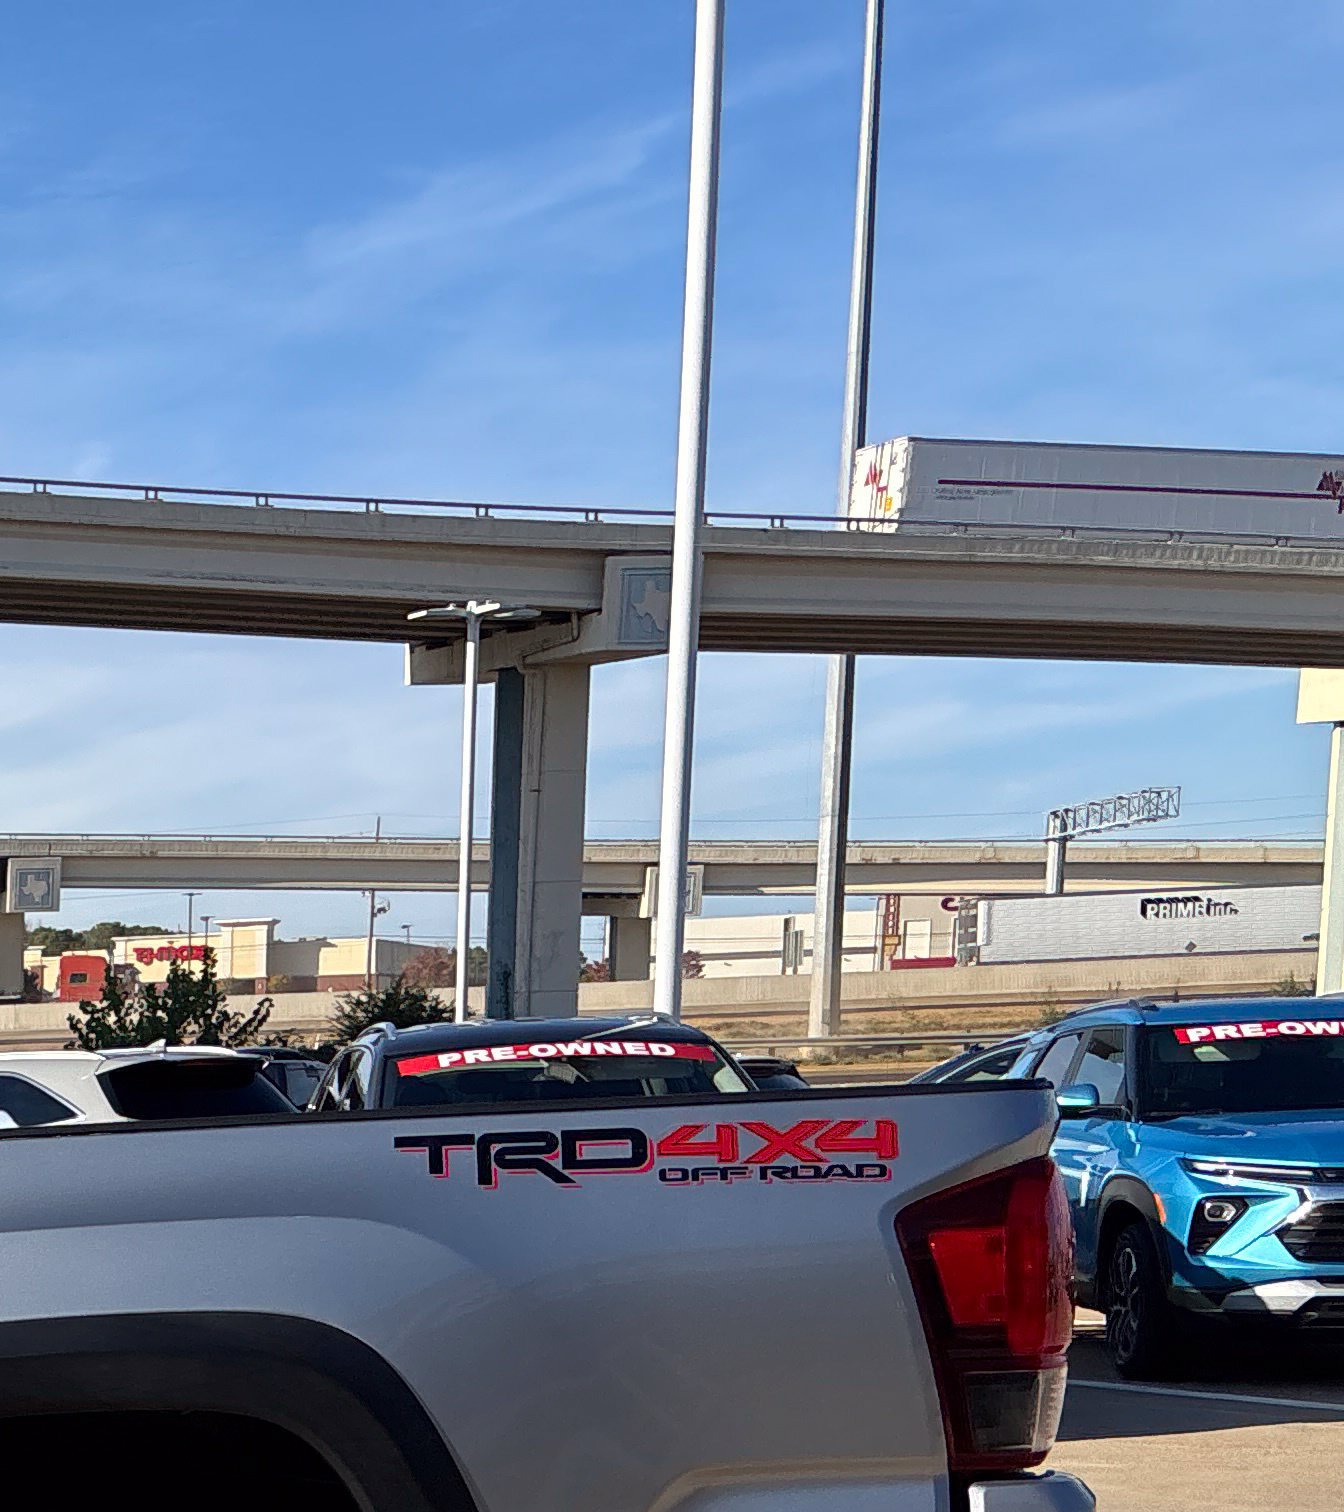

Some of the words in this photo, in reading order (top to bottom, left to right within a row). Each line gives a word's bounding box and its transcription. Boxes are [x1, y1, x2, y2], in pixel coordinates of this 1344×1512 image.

[1186, 1021, 1344, 1043] PRE-OW
[437, 1042, 676, 1067] PRE-OWNED
[394, 1127, 655, 1189] TRD
[657, 1119, 898, 1164] 4X4
[658, 1166, 753, 1184] OFF
[759, 1163, 892, 1183] ROAD
